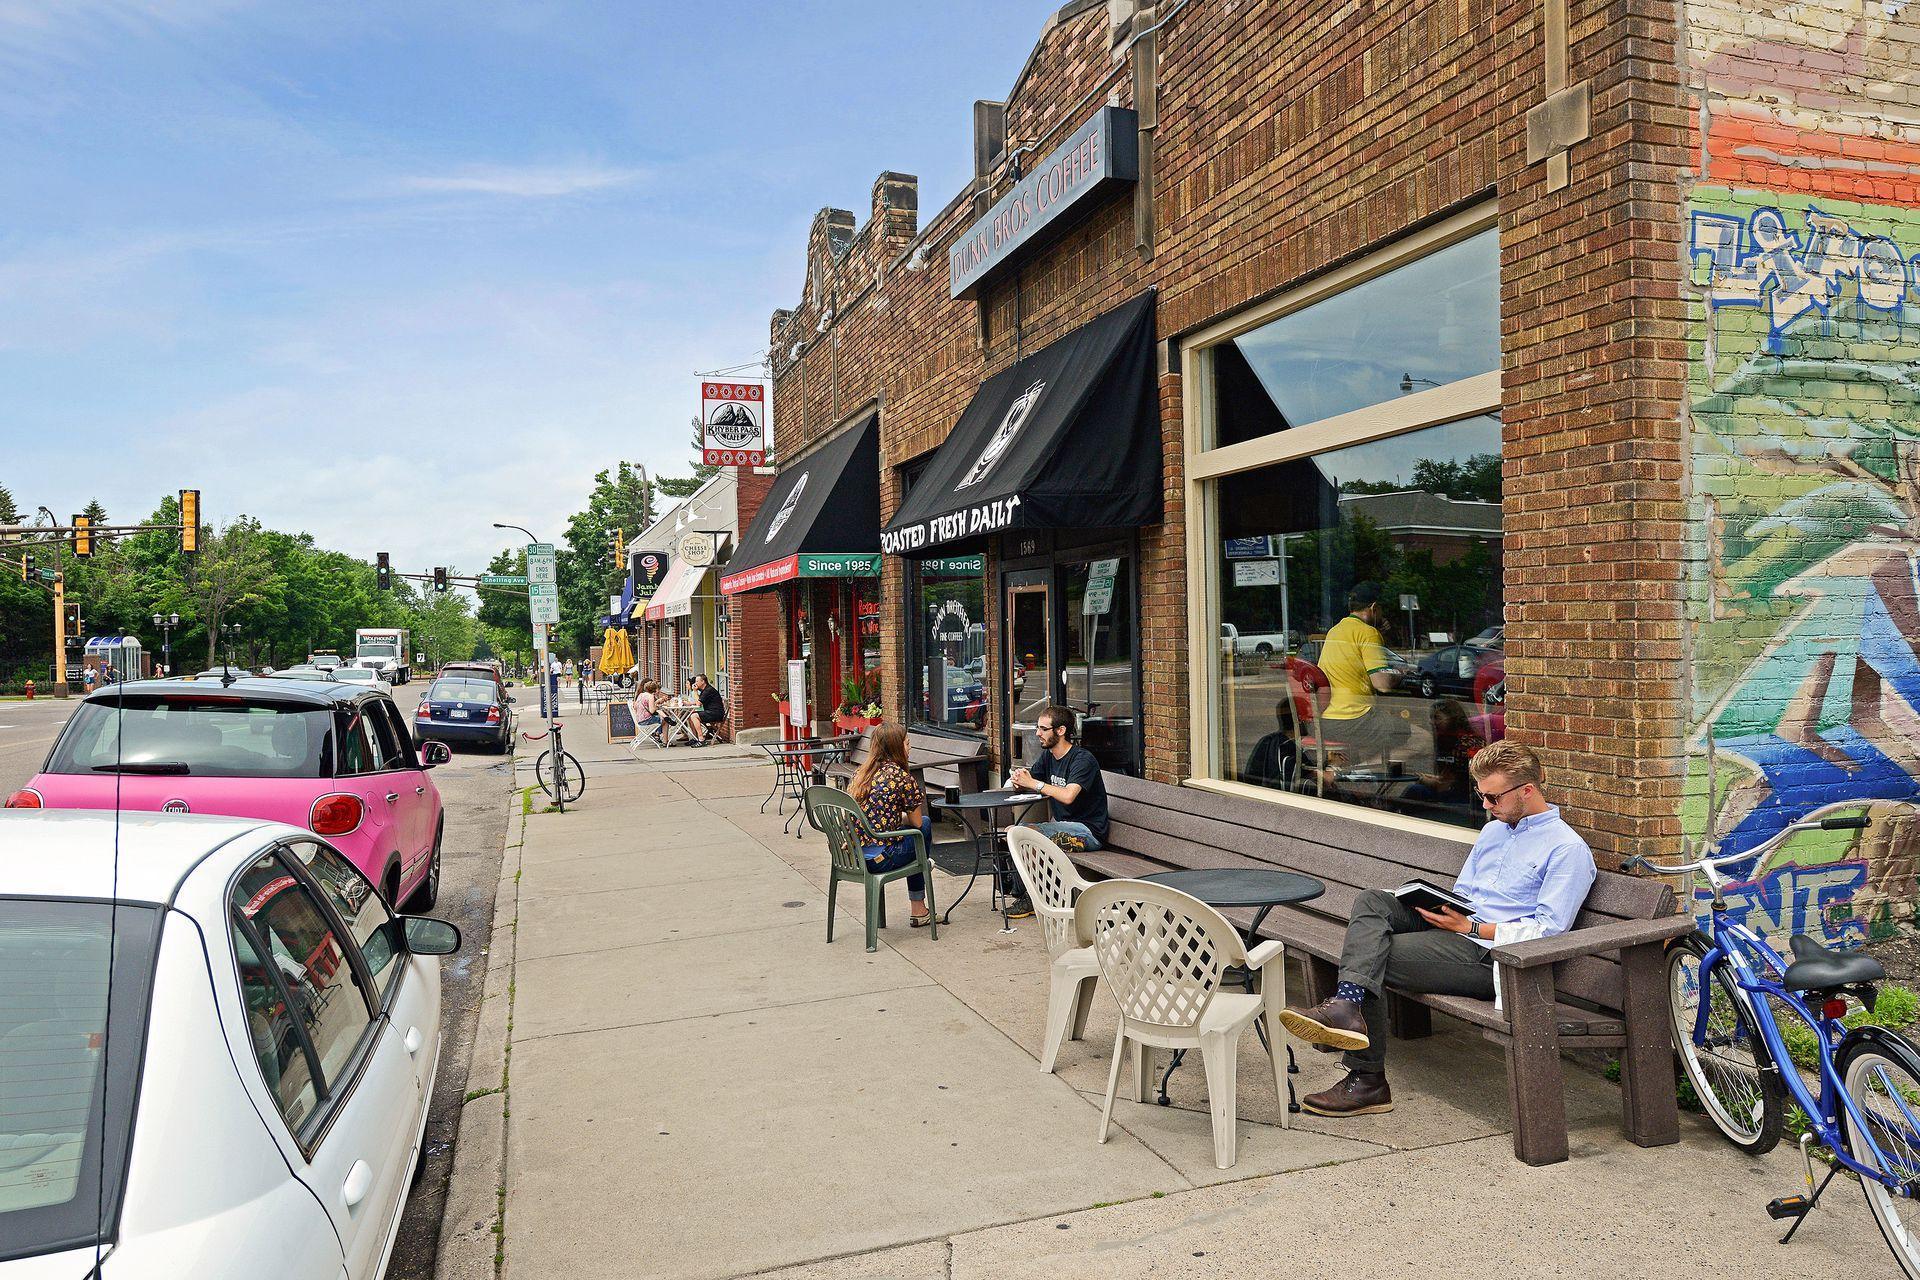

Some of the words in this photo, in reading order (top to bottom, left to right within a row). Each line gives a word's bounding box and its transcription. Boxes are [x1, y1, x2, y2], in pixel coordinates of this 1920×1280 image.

[953, 226, 989, 284] DUNN
[993, 190, 1031, 250] BROS
[1036, 129, 1099, 213] COFFEE
[707, 425, 740, 436] KHYBER
[740, 426, 760, 437] PASS
[881, 524, 925, 554] ROASTED
[929, 509, 968, 543] FRESH
[969, 494, 1021, 533] DAILY
[529, 545, 537, 554] 30
[808, 559, 842, 571] Since
[845, 560, 871, 571] 1985
[530, 586, 539, 595] 15
